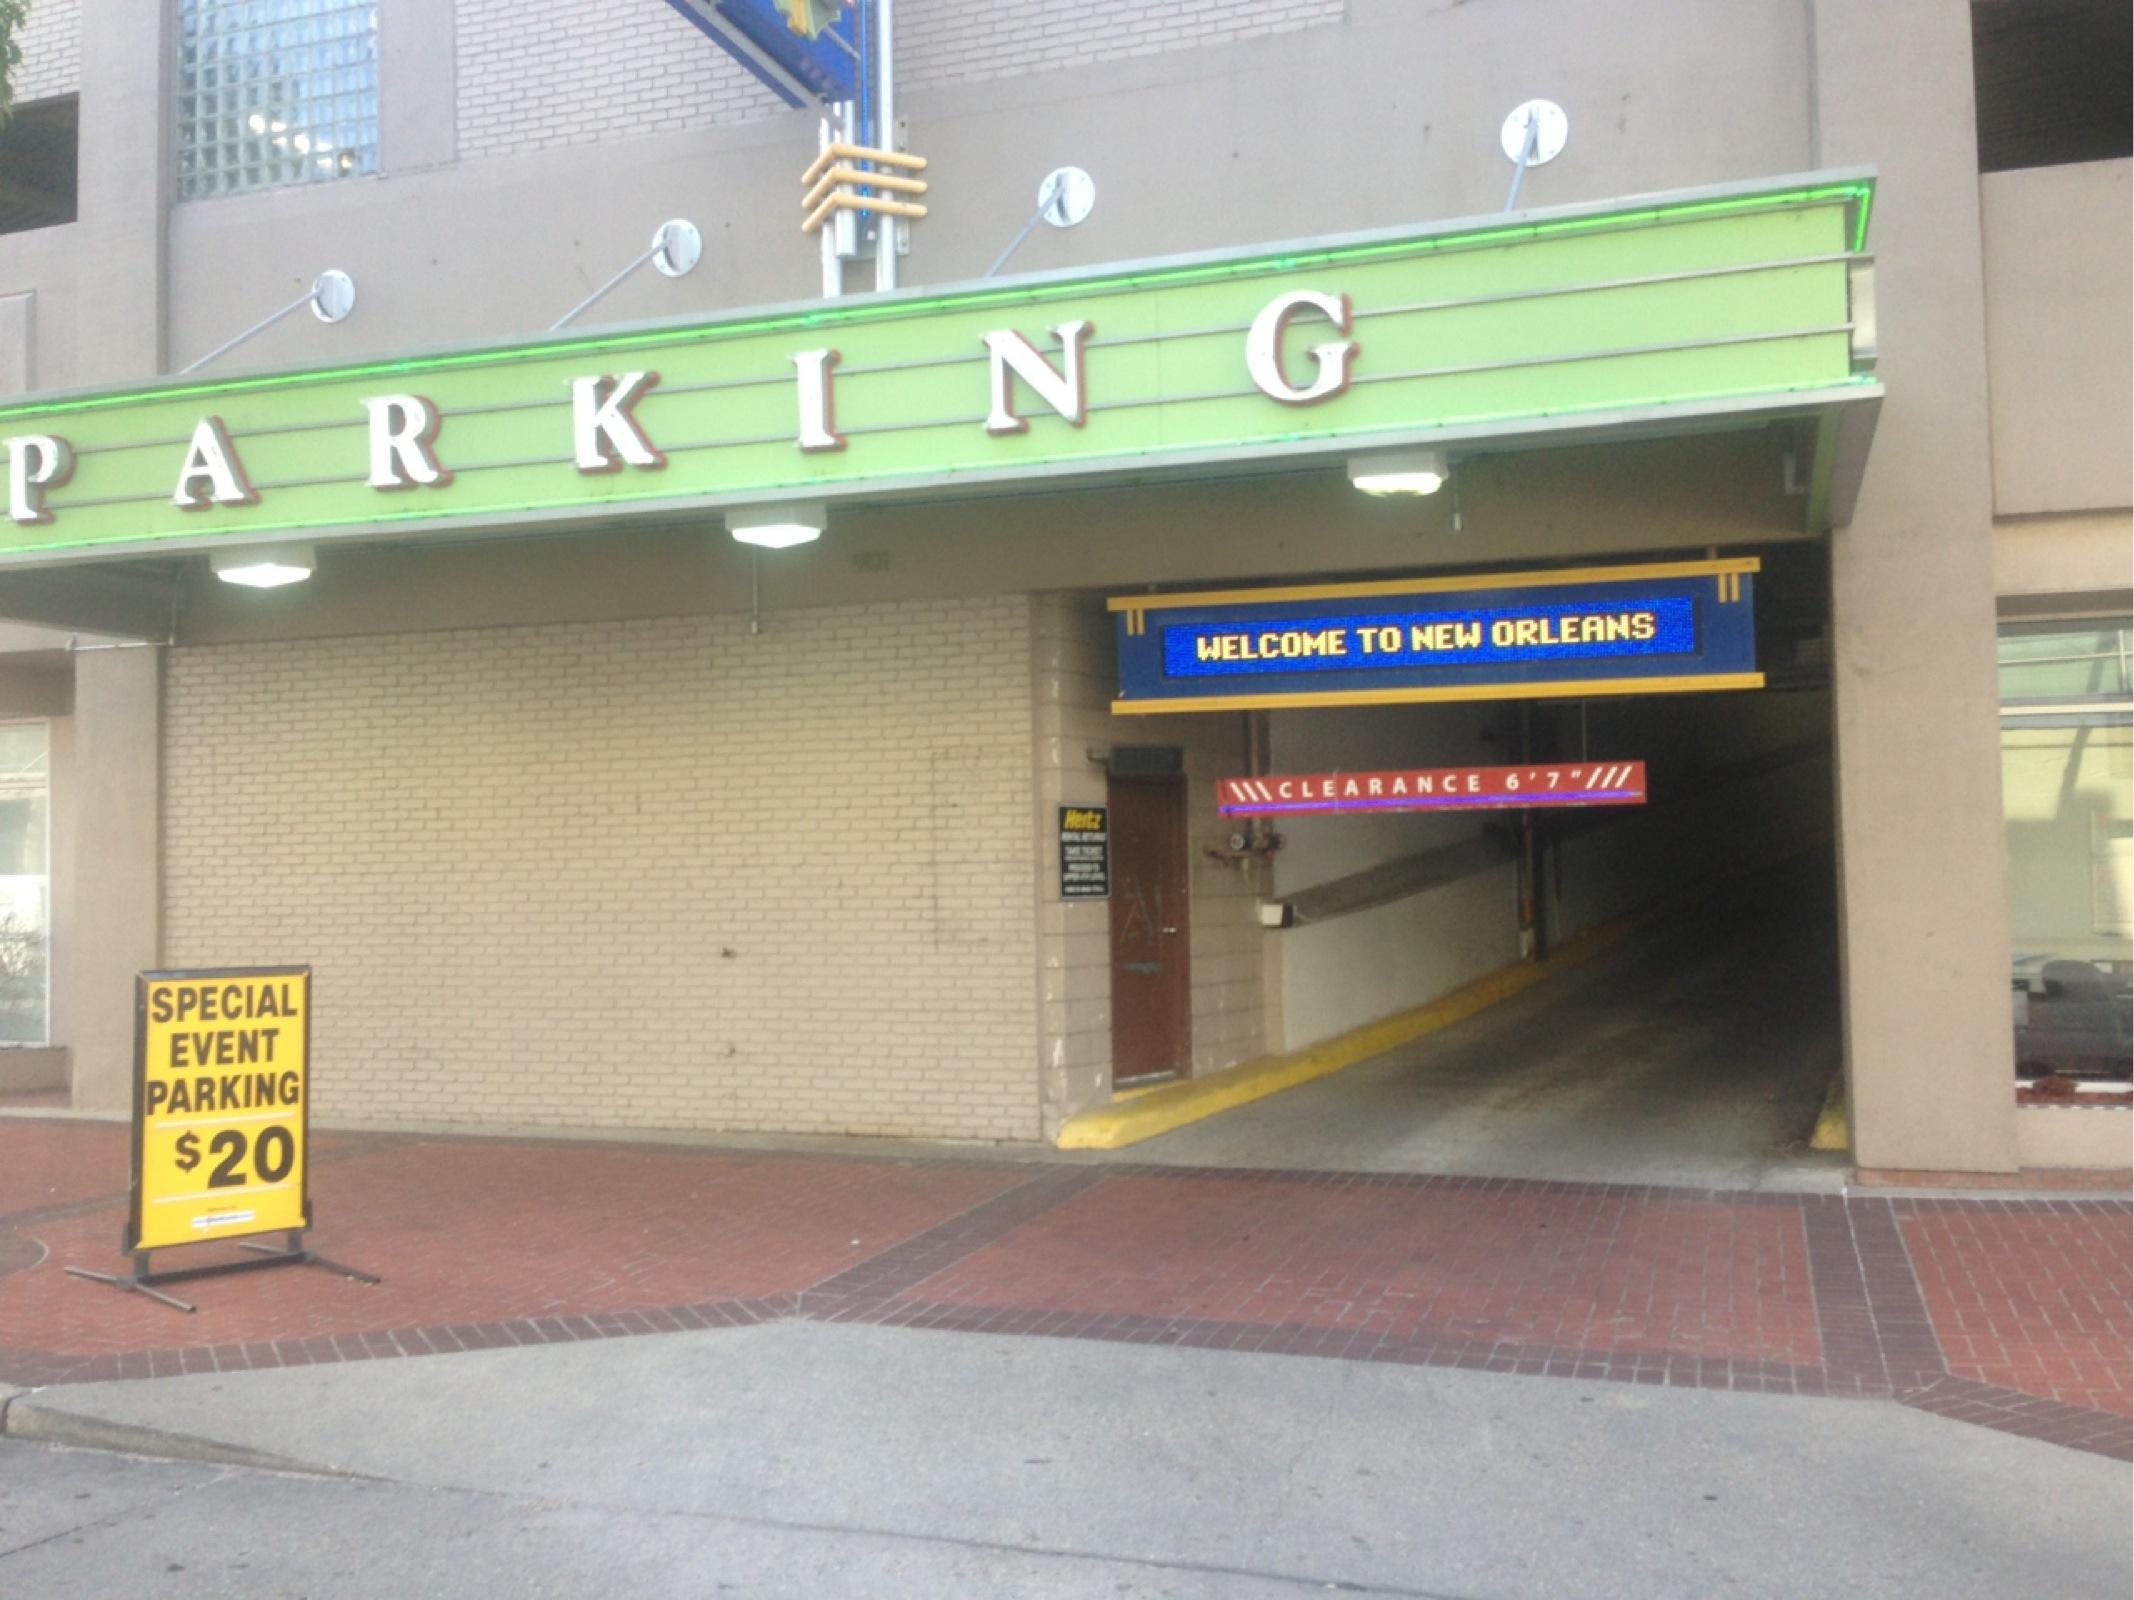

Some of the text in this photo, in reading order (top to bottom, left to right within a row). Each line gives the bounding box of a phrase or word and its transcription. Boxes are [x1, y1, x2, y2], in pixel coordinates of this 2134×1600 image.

[4, 289, 1361, 524] PARKING
[1196, 612, 1656, 661] WELCOME TO NEW ORLEANS
[1278, 773, 1481, 799] CLEARANCE
[1064, 809, 1104, 831] Hertz
[151, 984, 297, 1023] SPECIAL
[170, 1027, 279, 1068] EVENT
[146, 1070, 299, 1115] PARKING
[174, 1125, 295, 1189] $20
